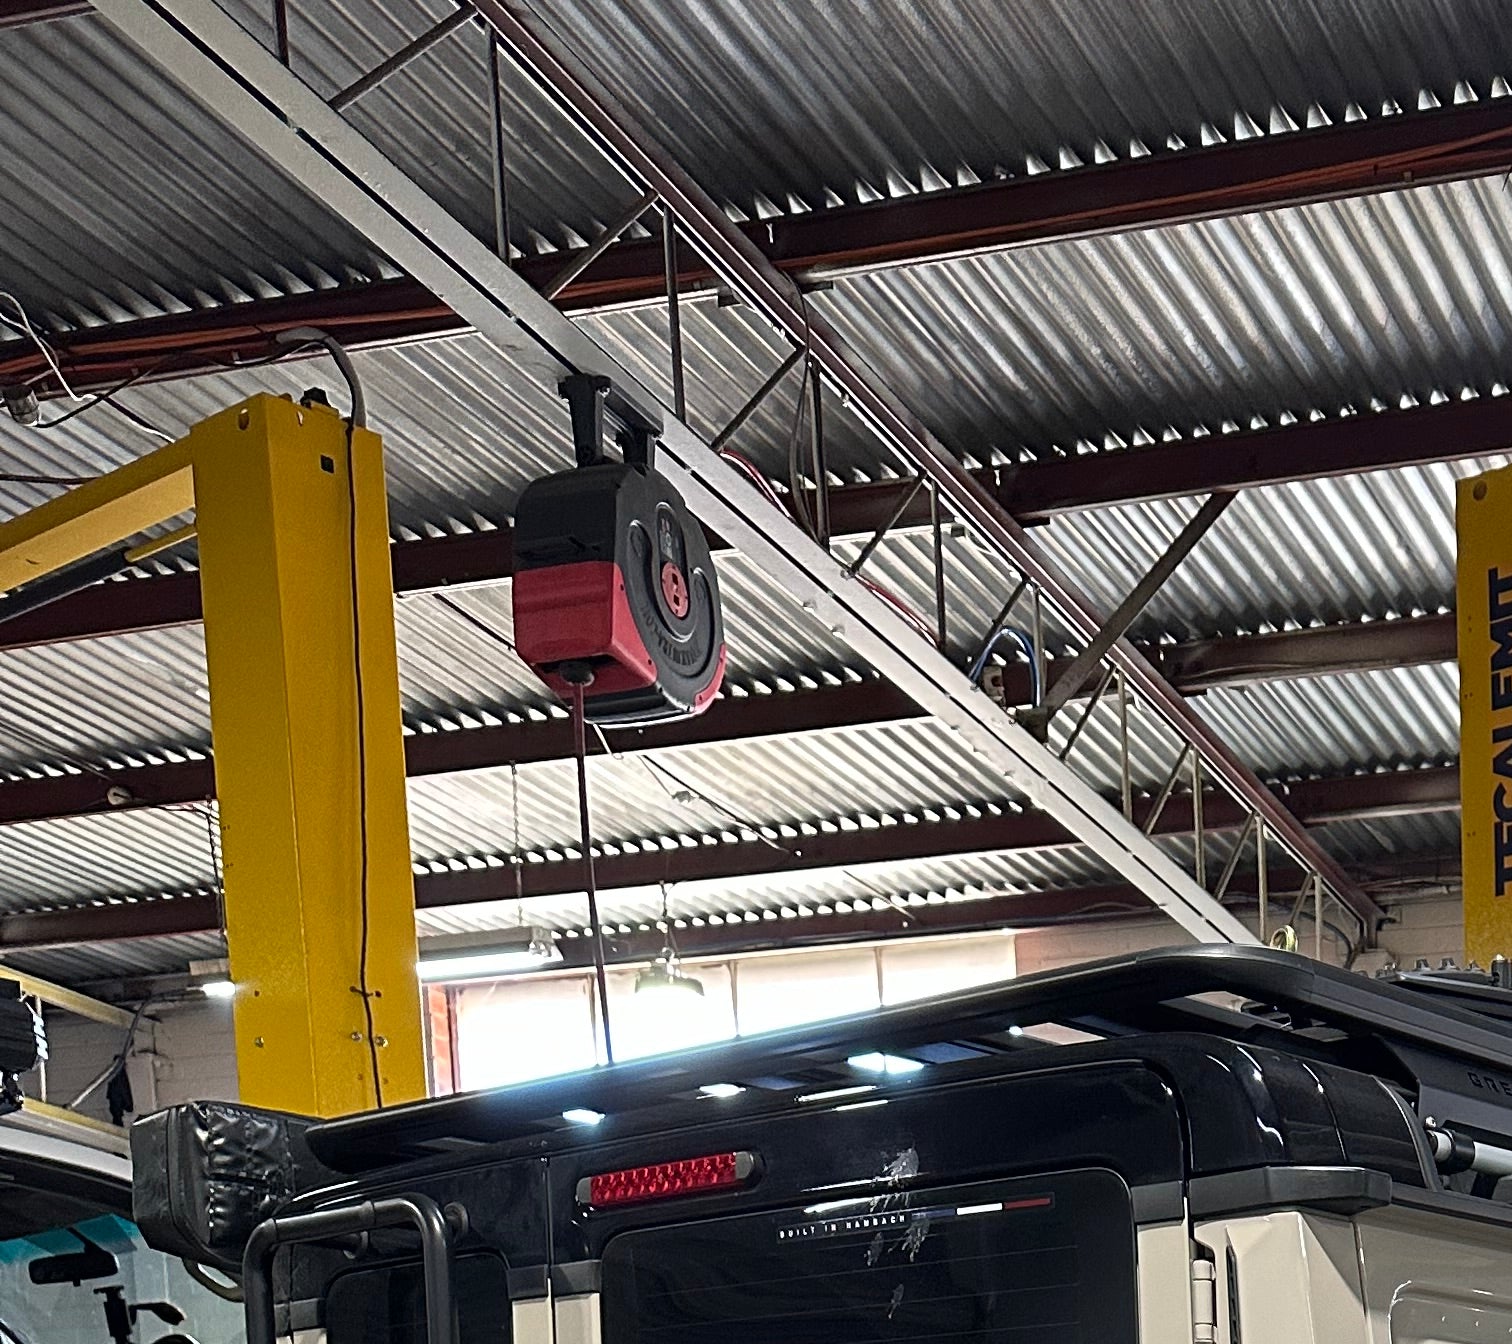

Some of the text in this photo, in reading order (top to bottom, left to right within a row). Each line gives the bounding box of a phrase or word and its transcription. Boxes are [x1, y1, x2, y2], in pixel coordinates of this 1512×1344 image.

[778, 1214, 906, 1239] BUILT IN HAMBACH
